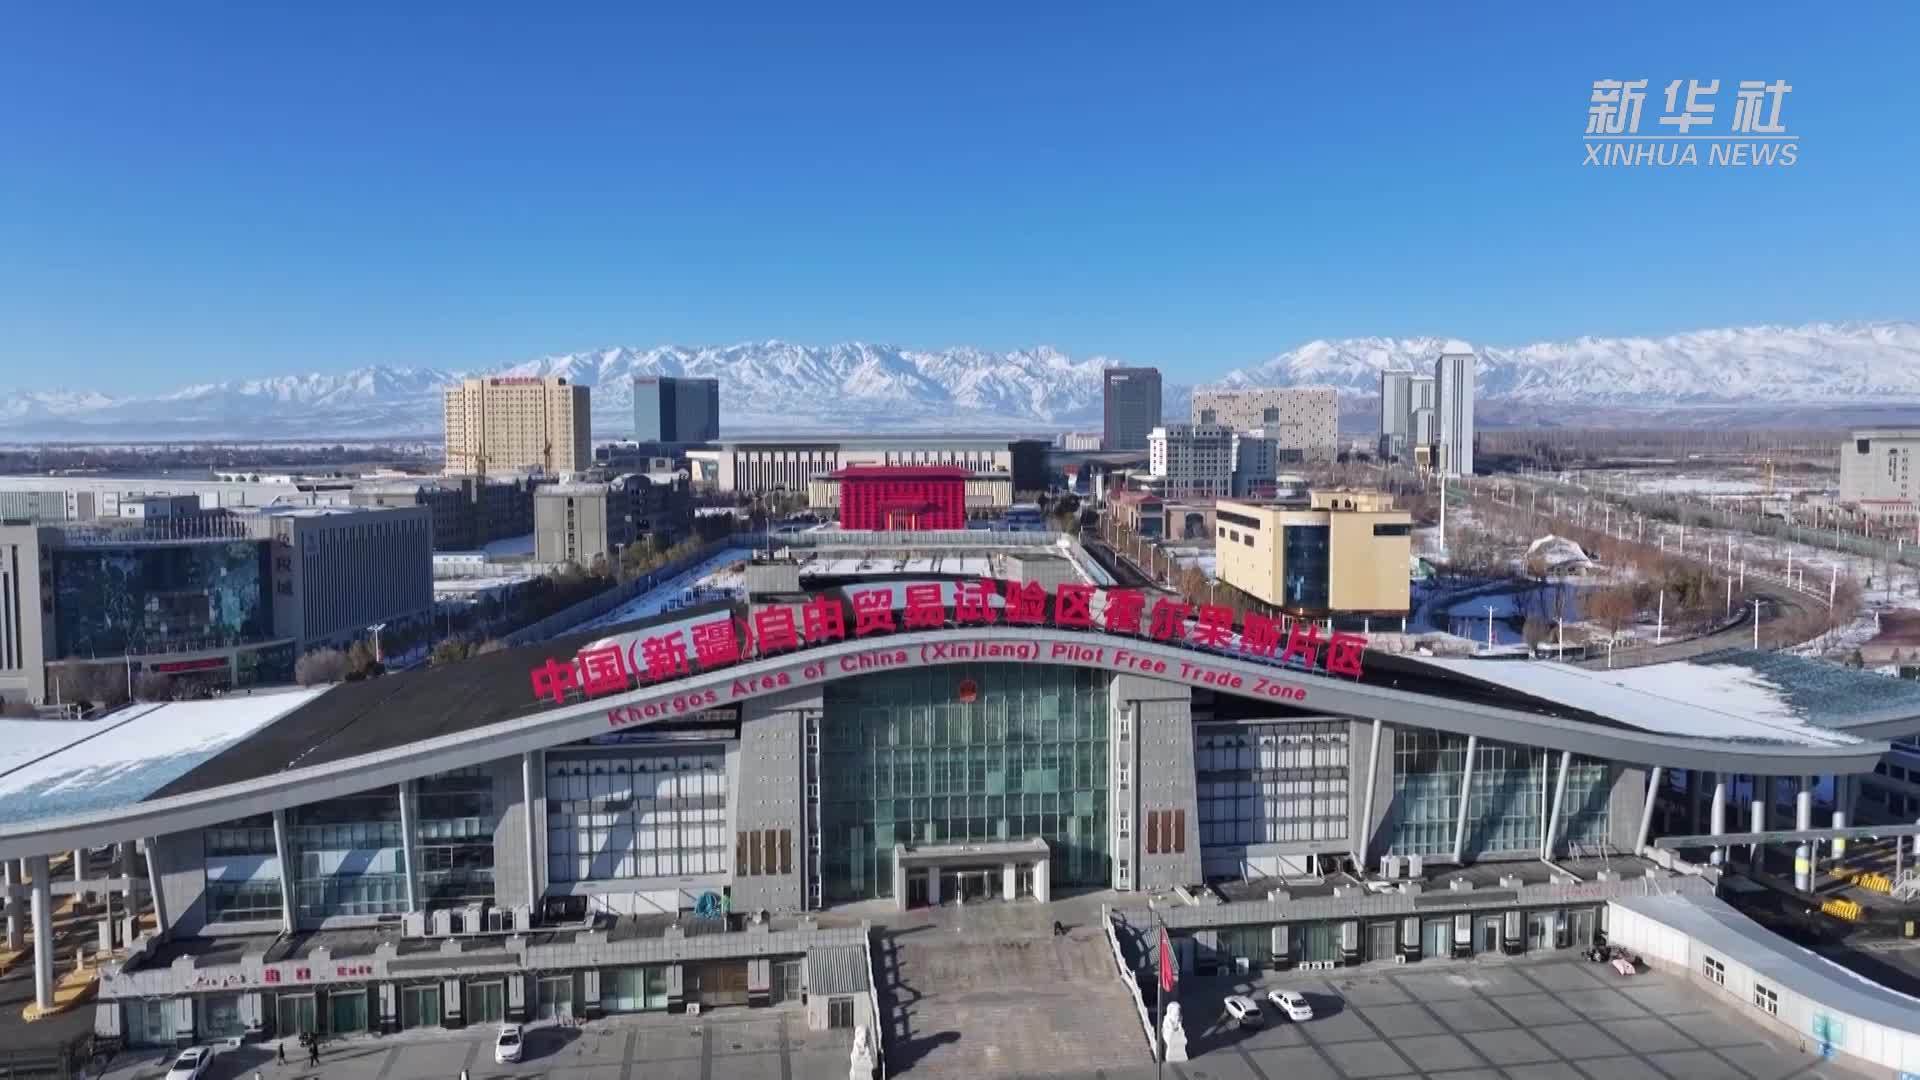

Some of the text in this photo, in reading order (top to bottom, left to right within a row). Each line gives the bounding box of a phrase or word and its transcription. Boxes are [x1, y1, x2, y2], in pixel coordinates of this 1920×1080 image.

[607, 640, 1307, 727] Khorgos Area of China (Xinjiang) Pilot Free Trade Zone
